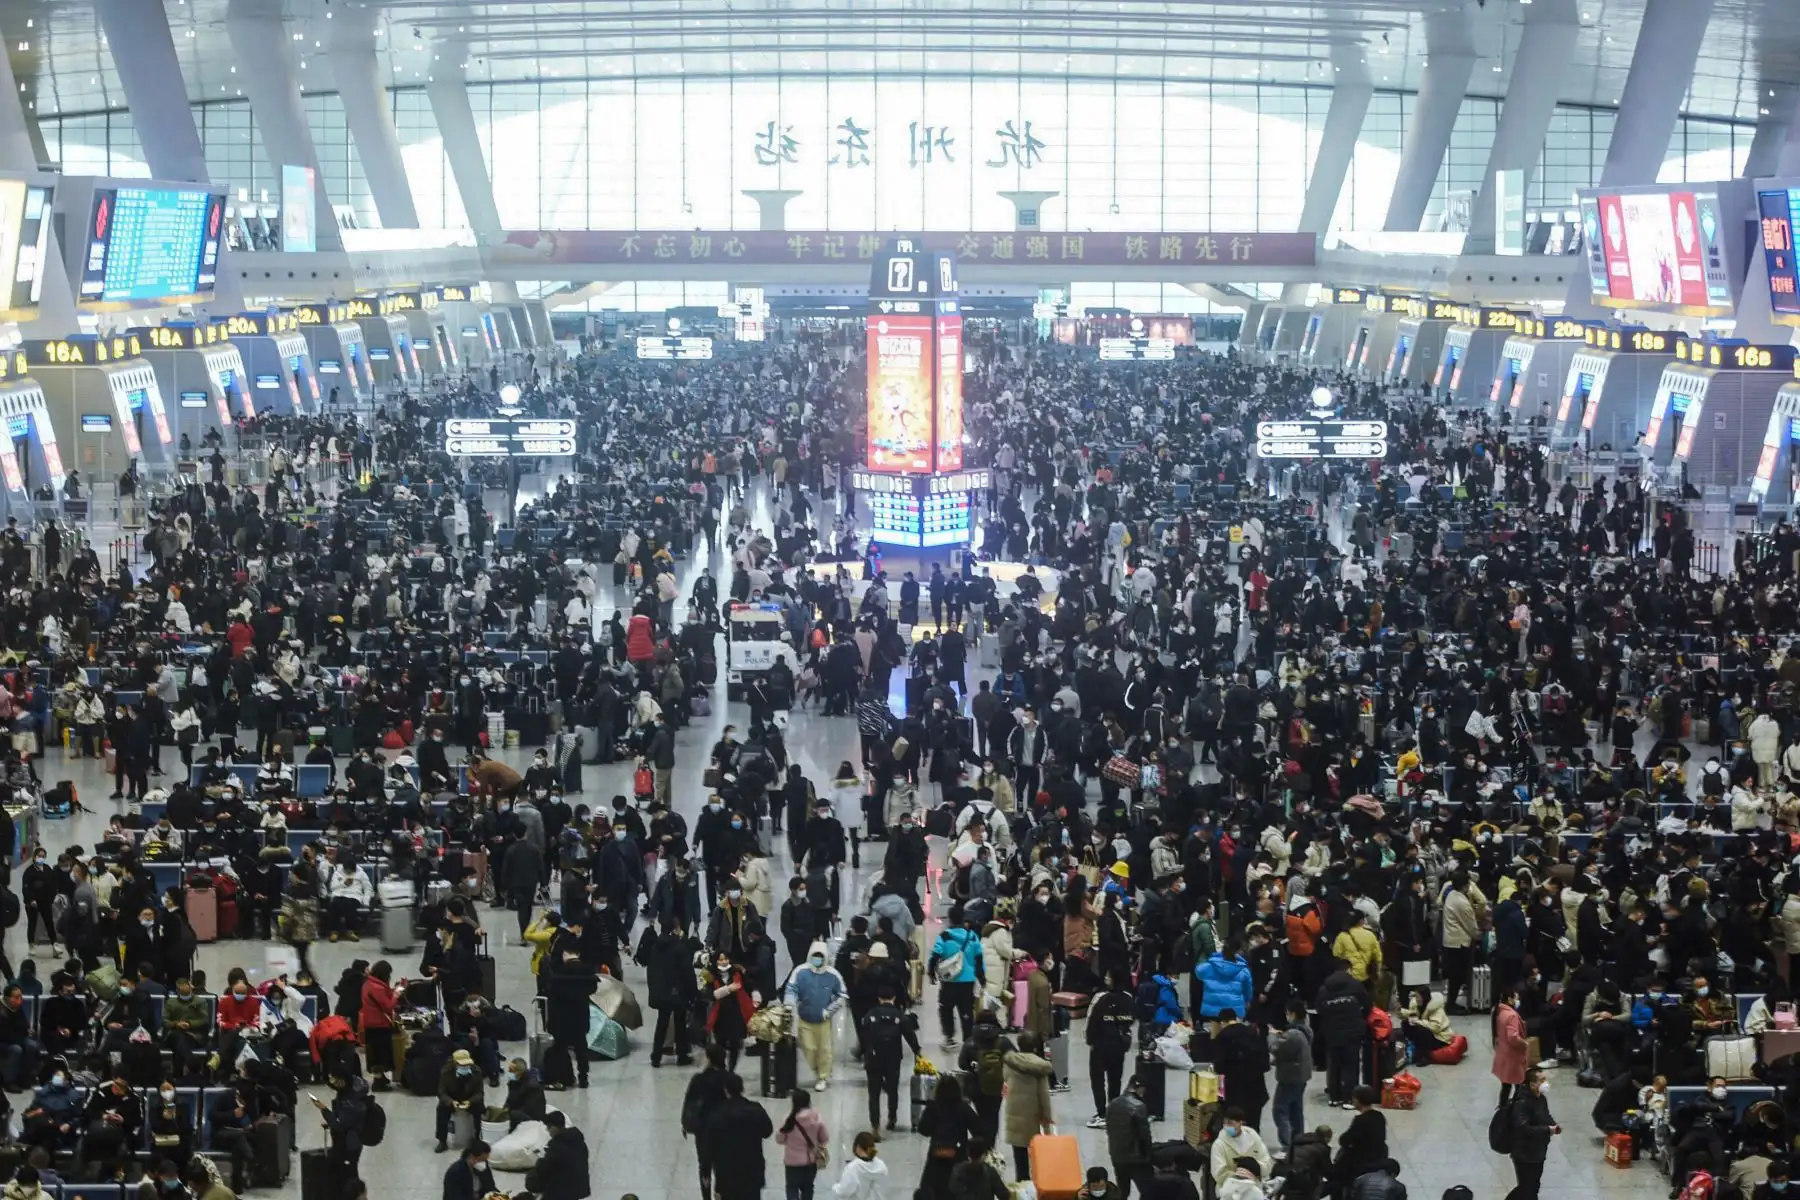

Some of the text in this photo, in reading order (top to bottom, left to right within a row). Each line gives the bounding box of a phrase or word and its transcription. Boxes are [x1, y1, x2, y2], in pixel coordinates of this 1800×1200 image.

[618, 234, 1254, 260] 不忘初心 牢记使 交通强国 铁路先行
[227, 316, 257, 334] 20A
[1554, 320, 1583, 337] 20B
[150, 327, 183, 346] 18A
[1632, 332, 1665, 350] 18B
[46, 341, 83, 362] 16A
[1735, 347, 1772, 366] 16B
